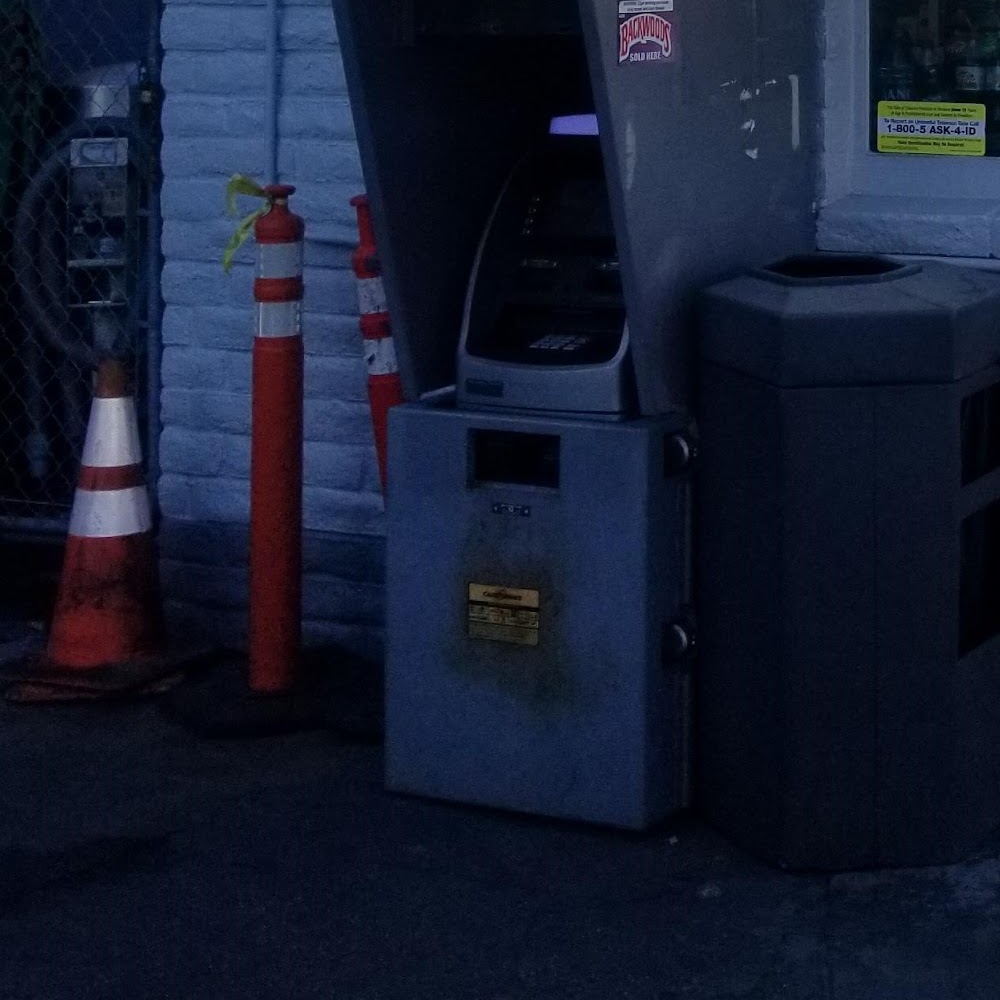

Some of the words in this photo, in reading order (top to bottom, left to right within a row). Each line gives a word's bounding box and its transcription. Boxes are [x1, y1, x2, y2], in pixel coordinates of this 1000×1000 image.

[619, 14, 672, 62] BACKWOODS
[630, 52, 645, 62] SOLD
[646, 51, 662, 61] HERE
[886, 124, 926, 134] 1-800-5
[929, 125, 976, 136] ASK-4-ID
